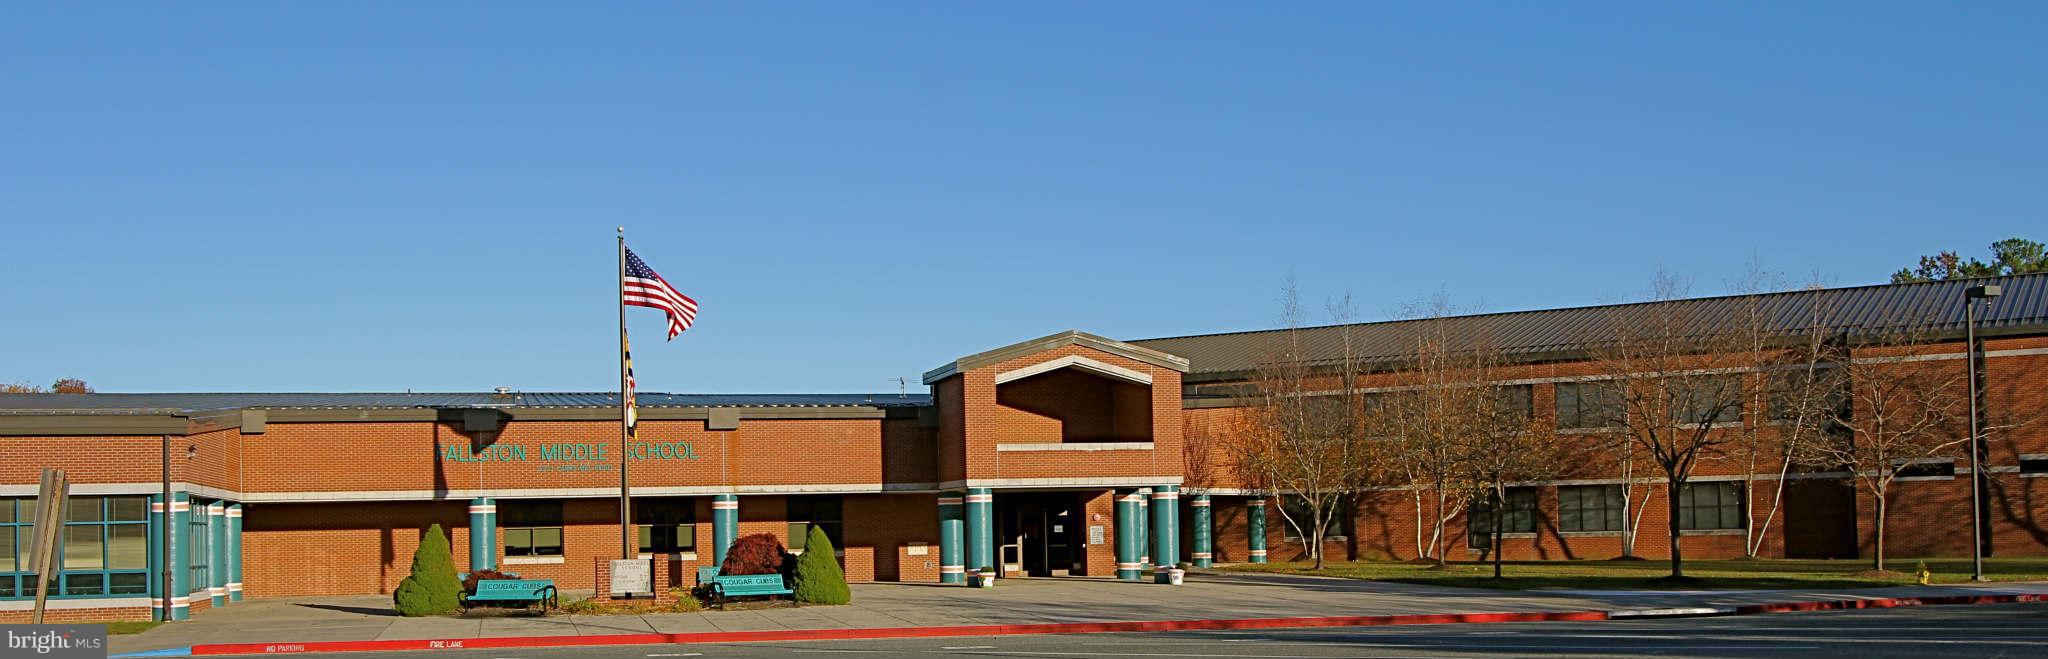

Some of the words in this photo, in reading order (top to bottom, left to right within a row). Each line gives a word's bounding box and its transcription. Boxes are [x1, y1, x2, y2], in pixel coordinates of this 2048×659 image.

[541, 442, 608, 461] MIDDLE
[429, 641, 445, 649] FIRE
[446, 640, 464, 648] LANE
